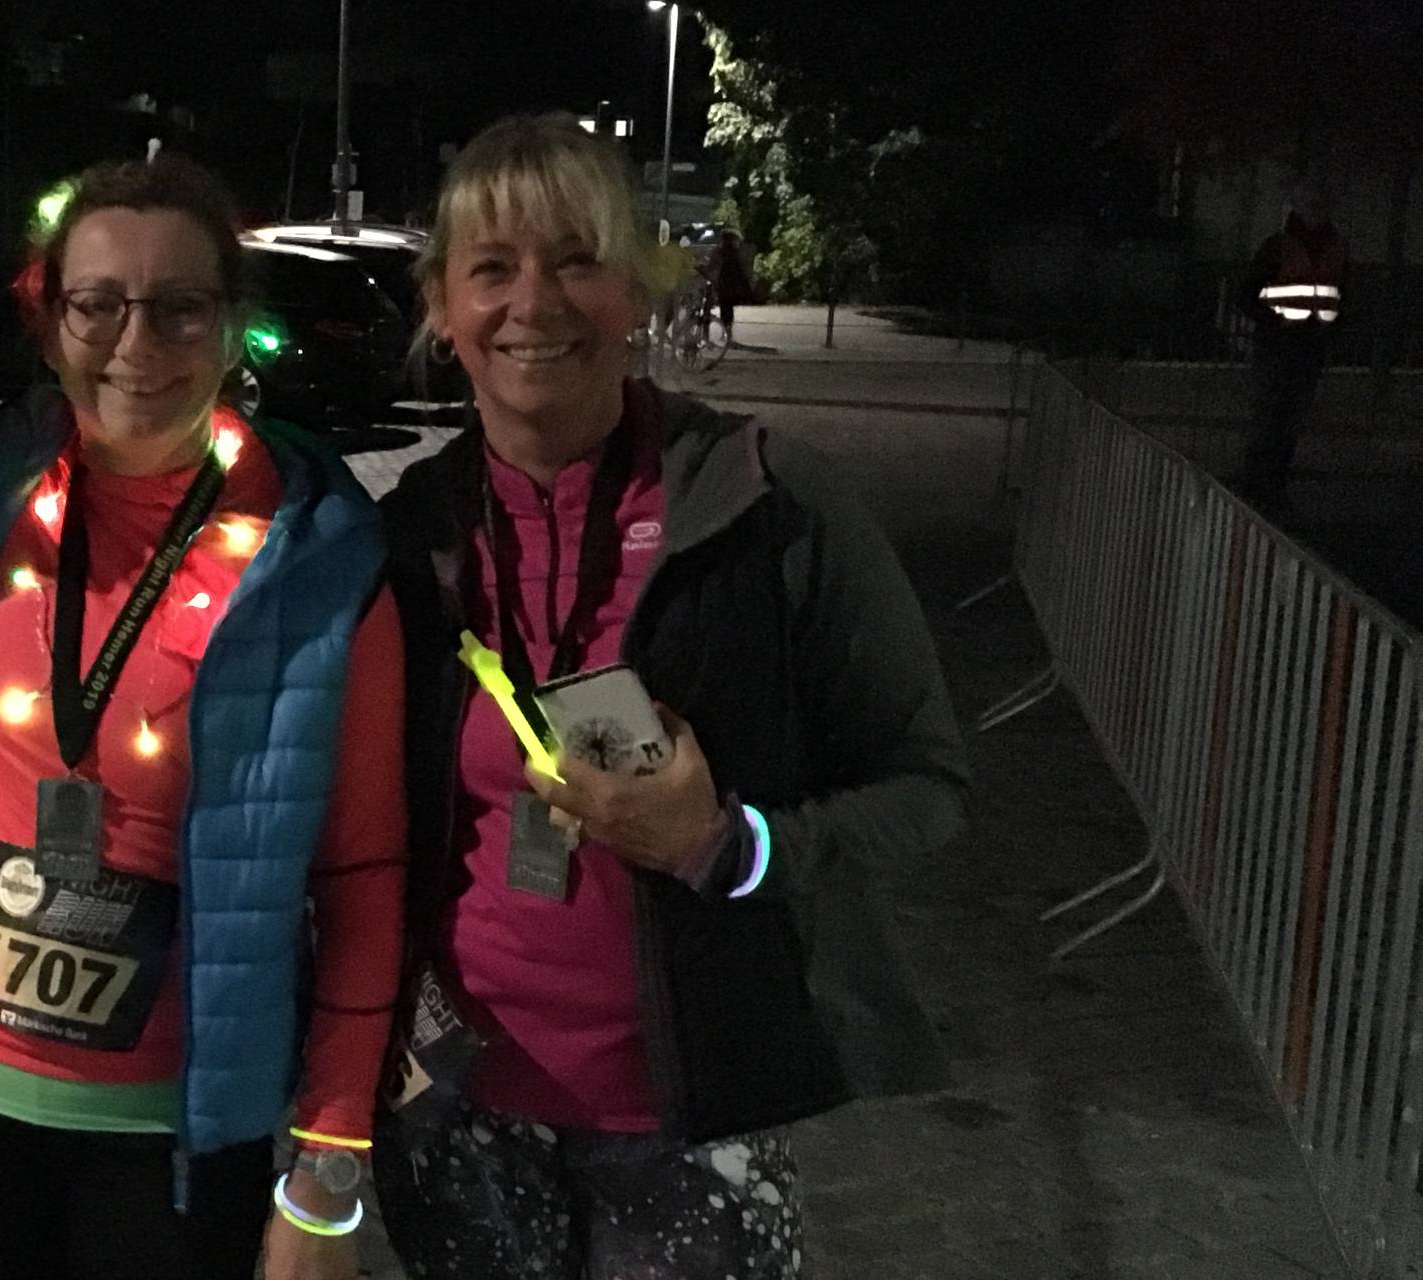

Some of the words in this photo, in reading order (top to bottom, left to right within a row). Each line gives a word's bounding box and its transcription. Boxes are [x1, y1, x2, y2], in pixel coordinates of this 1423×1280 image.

[148, 543, 178, 587] Night
[128, 586, 157, 618] Run
[100, 618, 137, 671] Hemer
[82, 670, 110, 711] 2019
